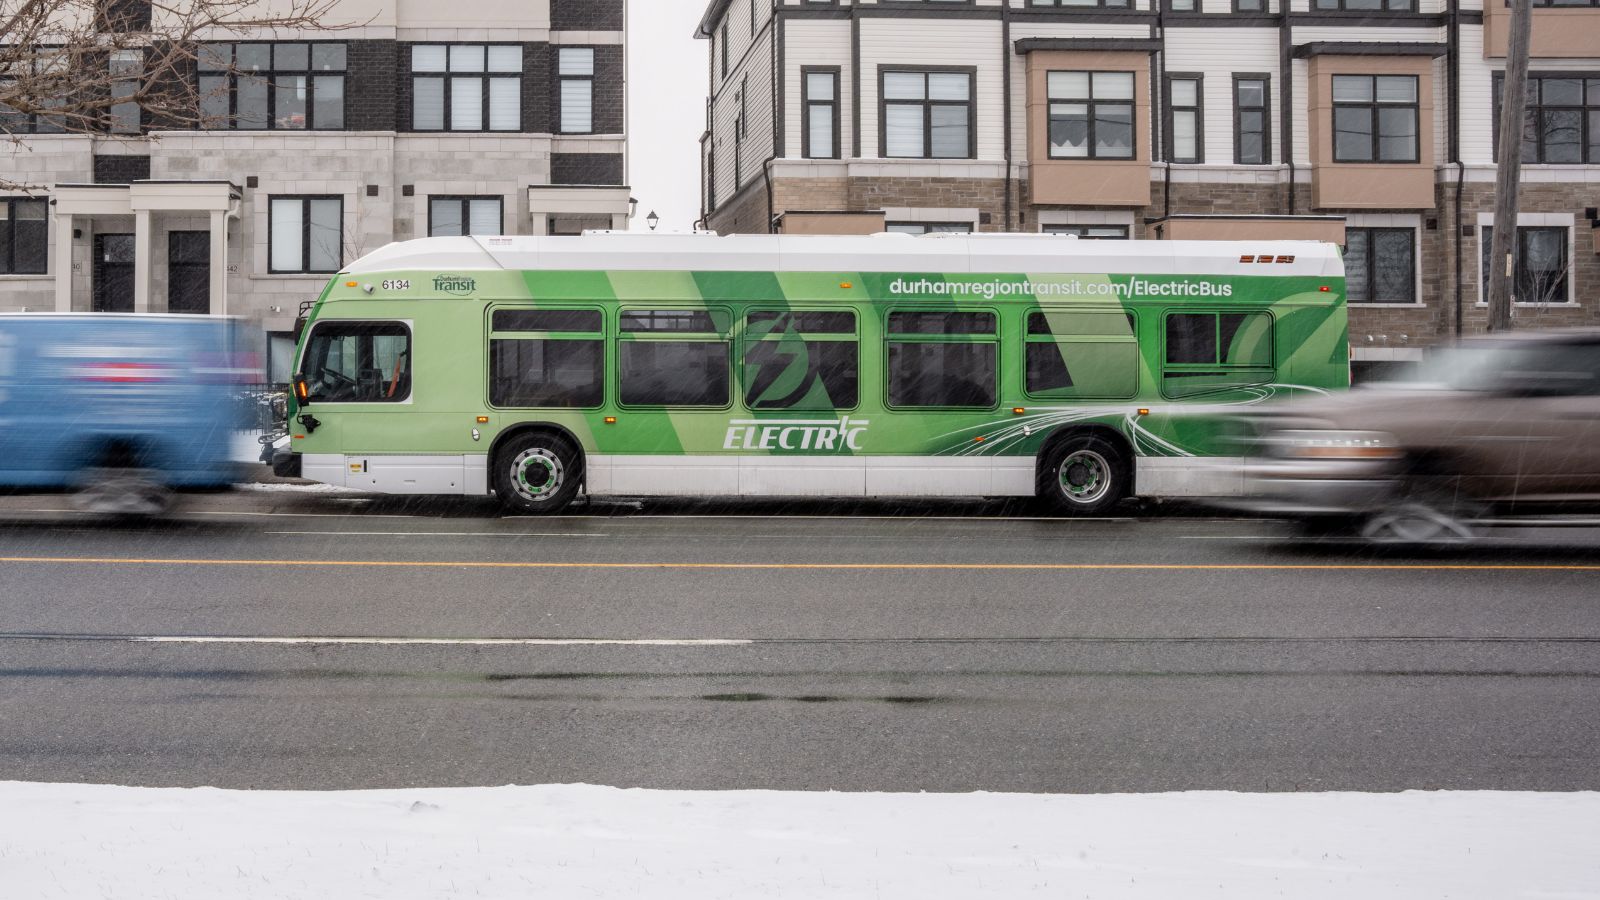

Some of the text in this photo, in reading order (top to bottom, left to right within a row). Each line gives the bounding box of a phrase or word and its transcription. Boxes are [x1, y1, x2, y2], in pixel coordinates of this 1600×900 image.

[382, 280, 410, 290] 6134
[432, 279, 477, 291] Transit
[889, 276, 1233, 299] durhamregiontransit.com/ElectricBus
[723, 416, 869, 452] ELECTRIC
